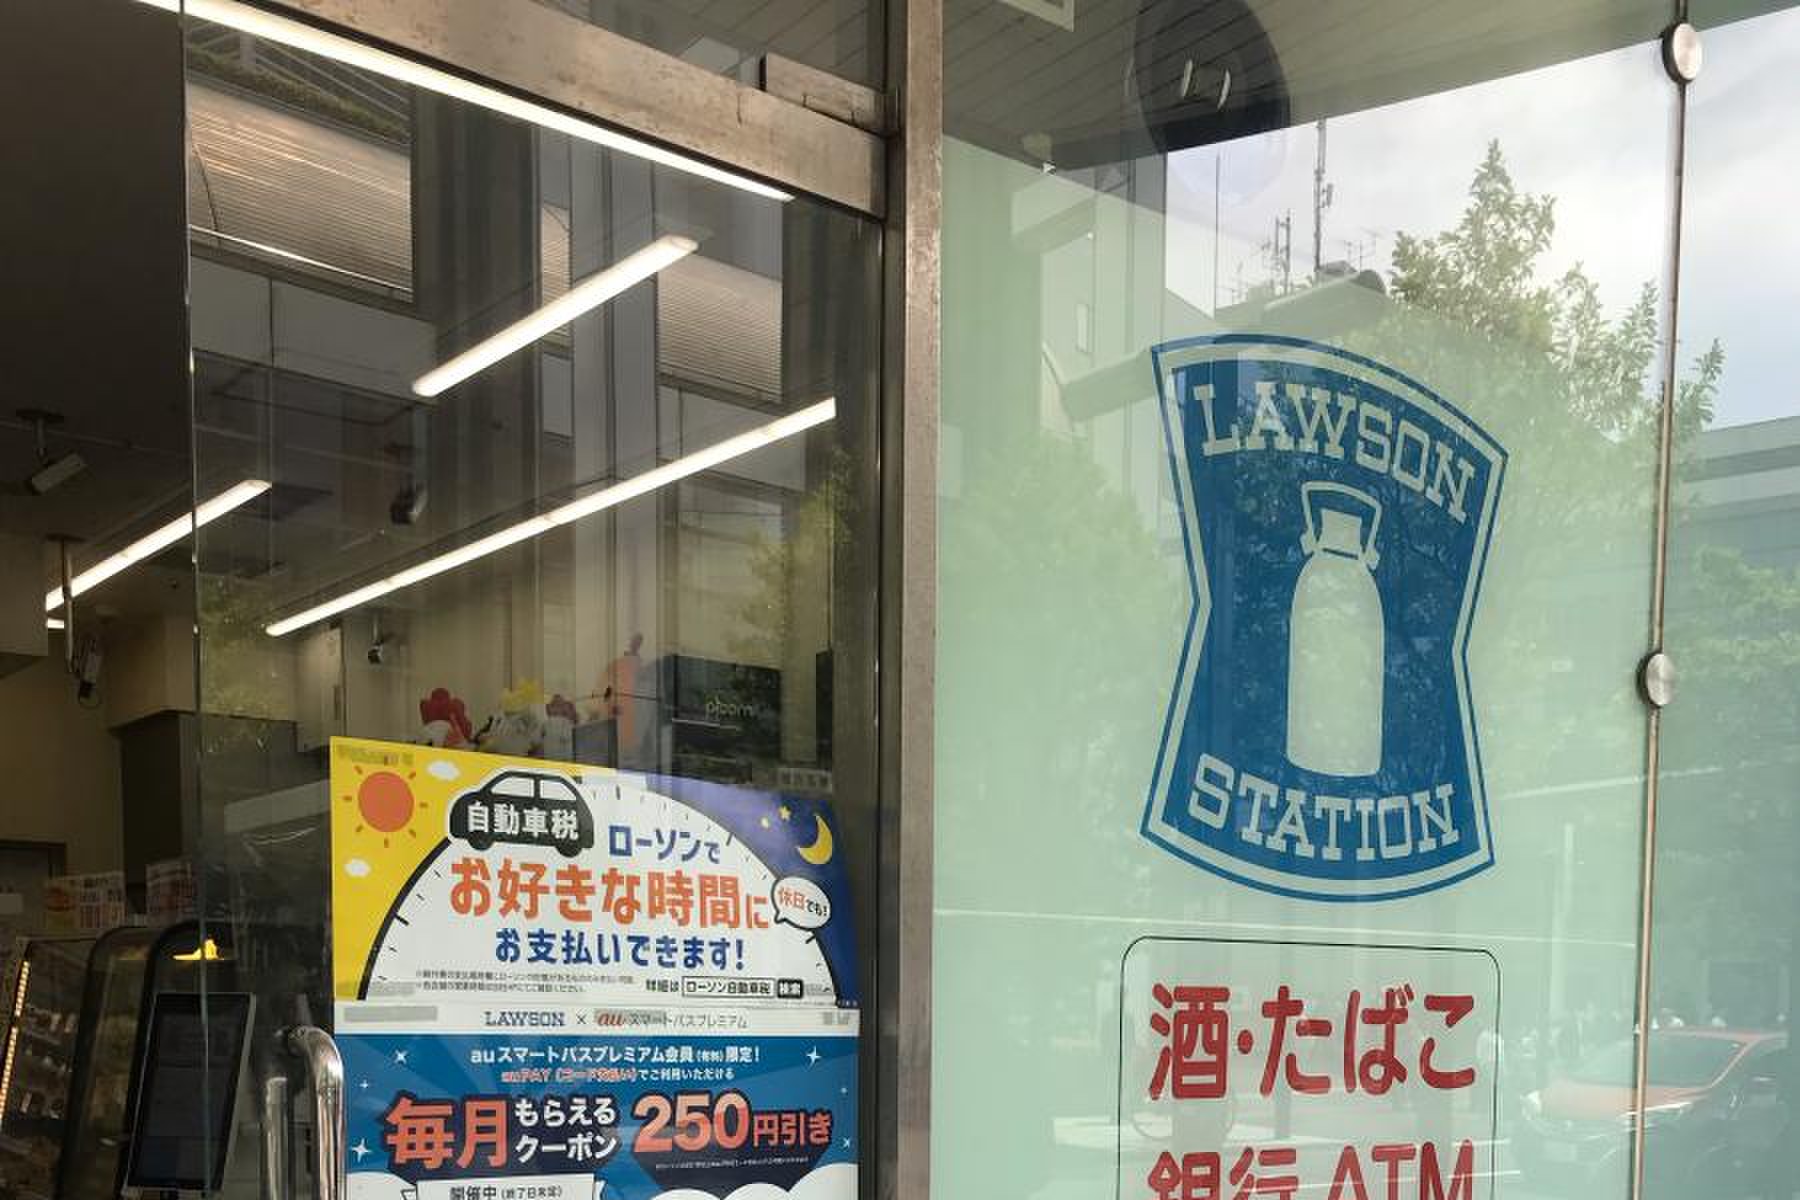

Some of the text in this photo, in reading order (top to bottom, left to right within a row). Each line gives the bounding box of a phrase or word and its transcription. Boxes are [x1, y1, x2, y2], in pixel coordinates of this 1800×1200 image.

[1192, 384, 1477, 523] LAWSON
[467, 802, 579, 841] 自動車税
[1188, 753, 1460, 863] STATION
[609, 825, 720, 862] ローソンで
[450, 858, 770, 929] お好きな時間に
[495, 928, 745, 970] お支払いできます!
[485, 1011, 566, 1027] LAWSON
[1148, 983, 1474, 1102] 酒・たばこ
[515, 1097, 615, 1127] もらえる
[387, 1096, 508, 1171] 毎月
[515, 1134, 617, 1163] クーポン
